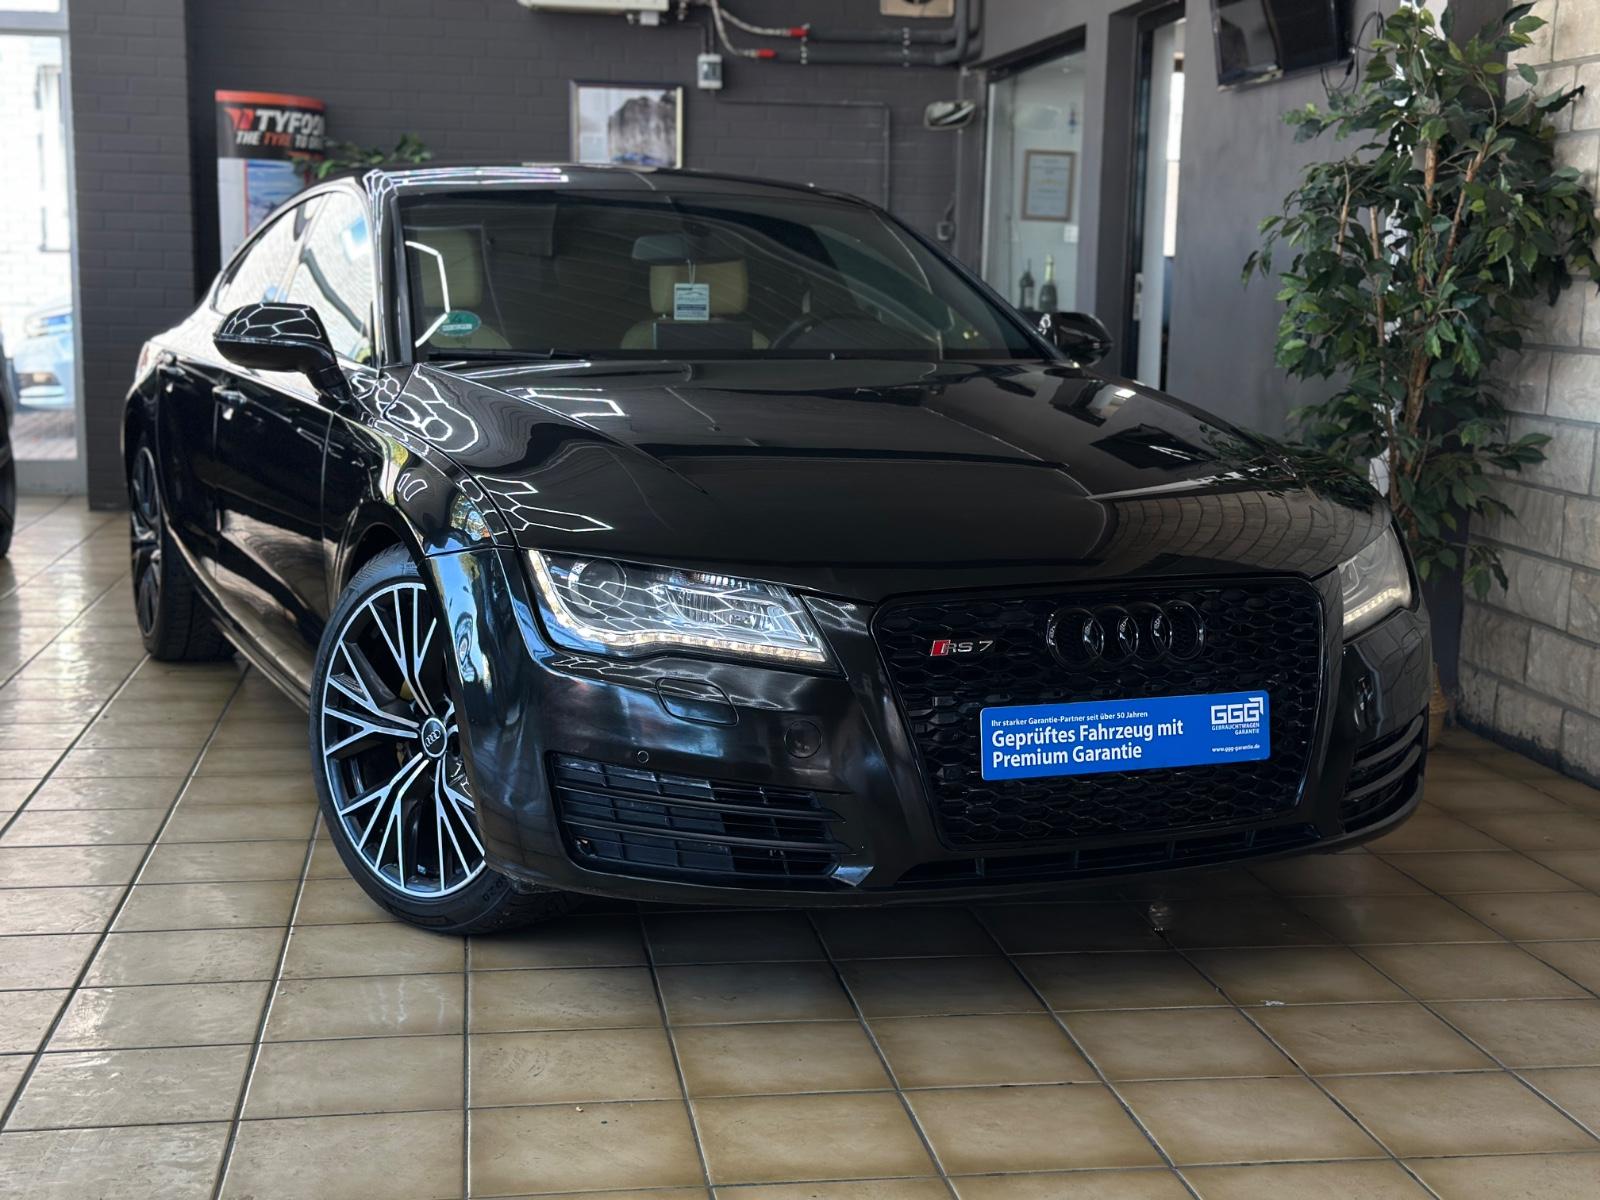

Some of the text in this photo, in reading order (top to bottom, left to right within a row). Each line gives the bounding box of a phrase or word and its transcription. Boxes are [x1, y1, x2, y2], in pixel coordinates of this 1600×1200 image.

[255, 108, 325, 136] TYFOO
[979, 641, 994, 652] 7
[991, 711, 1148, 727] Ihr starker Garantie-Partner seit über 50 Jahren
[1210, 702, 1261, 725] GGG
[991, 718, 1184, 750] Geprüftes Fahrzeug mit
[1211, 722, 1260, 731] GEBRAUCHTWAGEN
[1234, 728, 1260, 736] GARANTIE
[992, 742, 1142, 768] Premium Garantie
